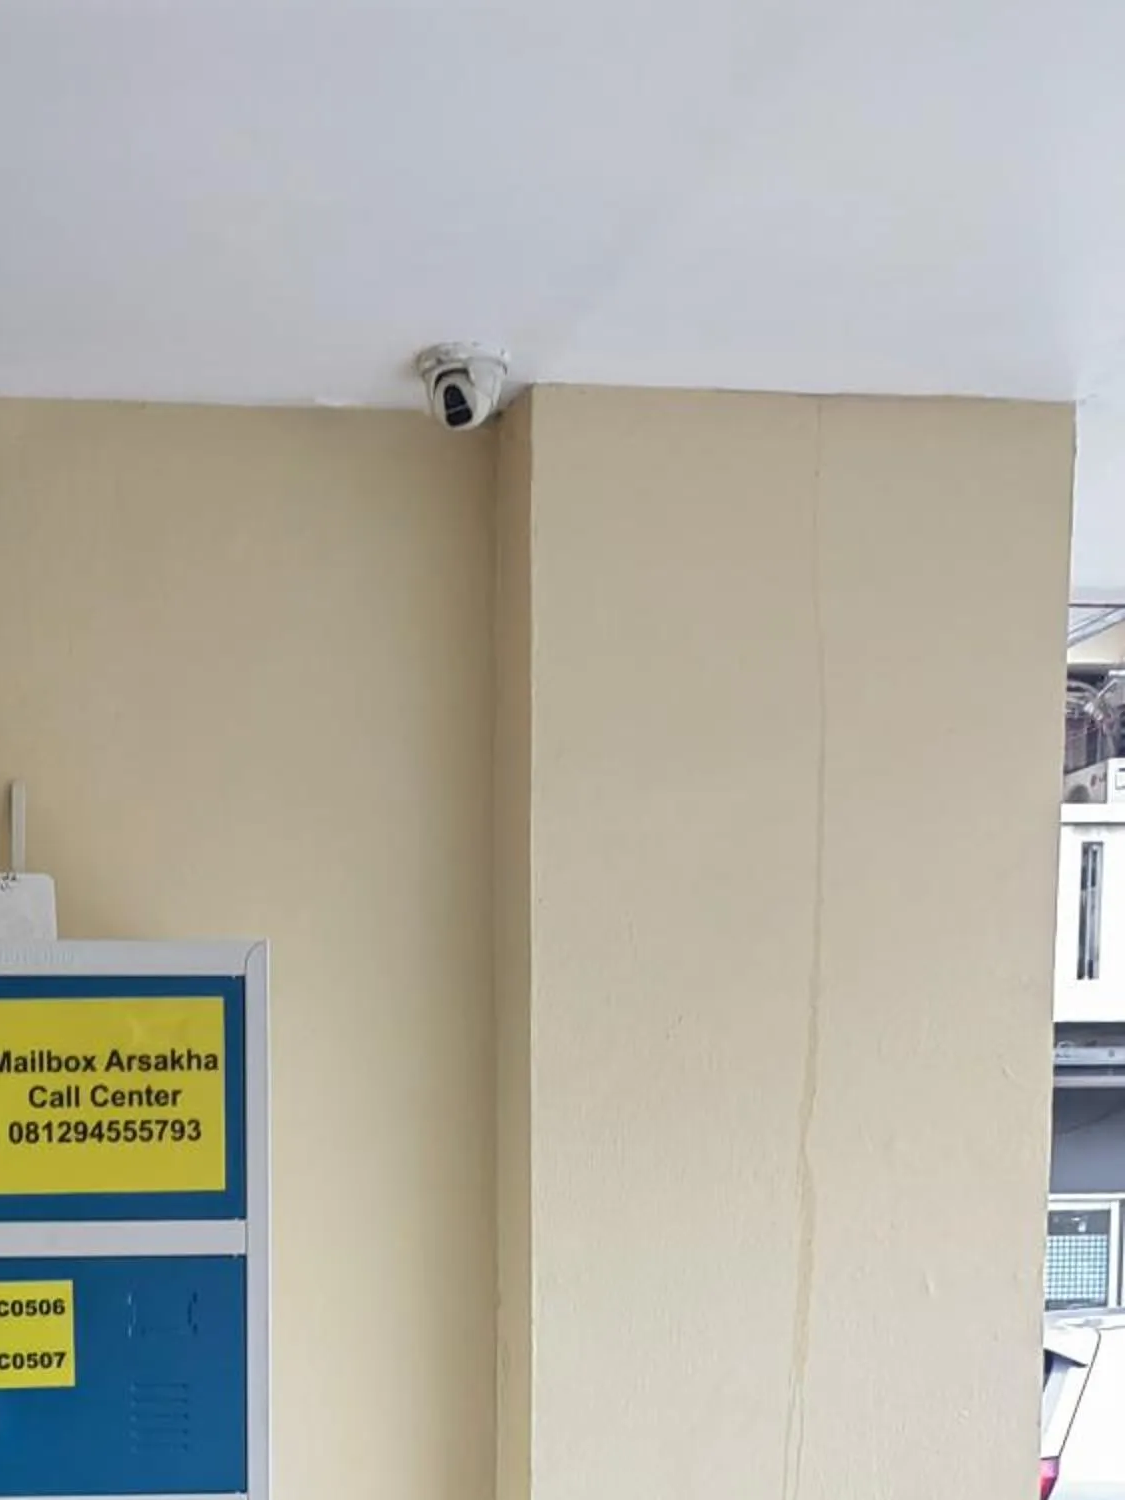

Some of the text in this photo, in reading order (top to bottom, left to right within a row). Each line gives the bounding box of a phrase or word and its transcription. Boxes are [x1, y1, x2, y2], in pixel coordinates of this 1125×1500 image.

[104, 1048, 219, 1072] Arsakha
[28, 1085, 182, 1109] Call Center
[8, 1119, 202, 1145] 081294555793
